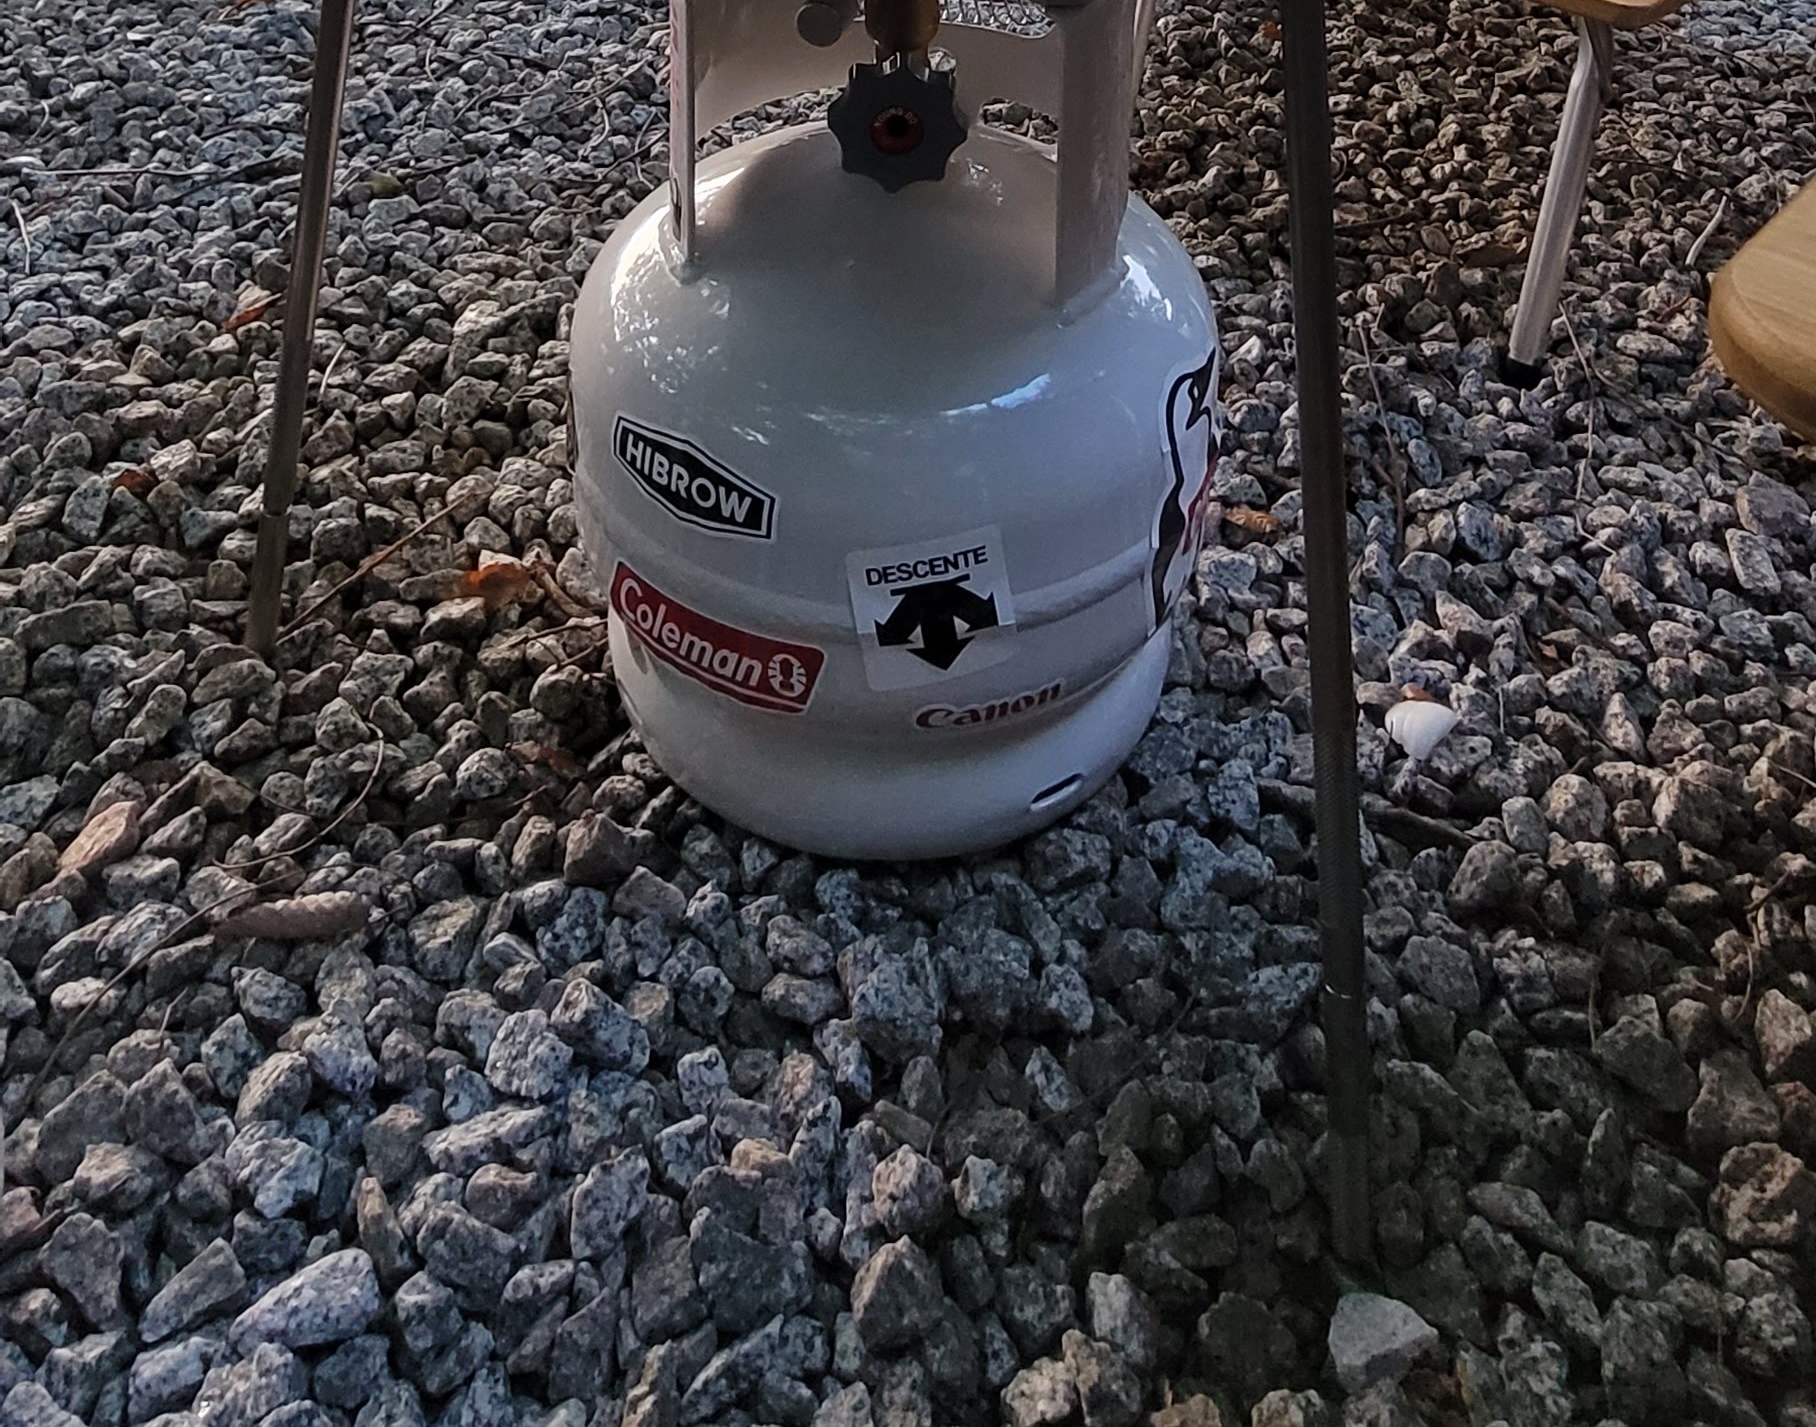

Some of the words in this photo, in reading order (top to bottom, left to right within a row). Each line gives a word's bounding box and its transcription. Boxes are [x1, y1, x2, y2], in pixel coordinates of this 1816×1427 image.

[625, 432, 752, 523] HIBROW
[865, 545, 988, 586] DESCENTE
[620, 578, 763, 686] Coleman
[915, 683, 1062, 729] Canon
